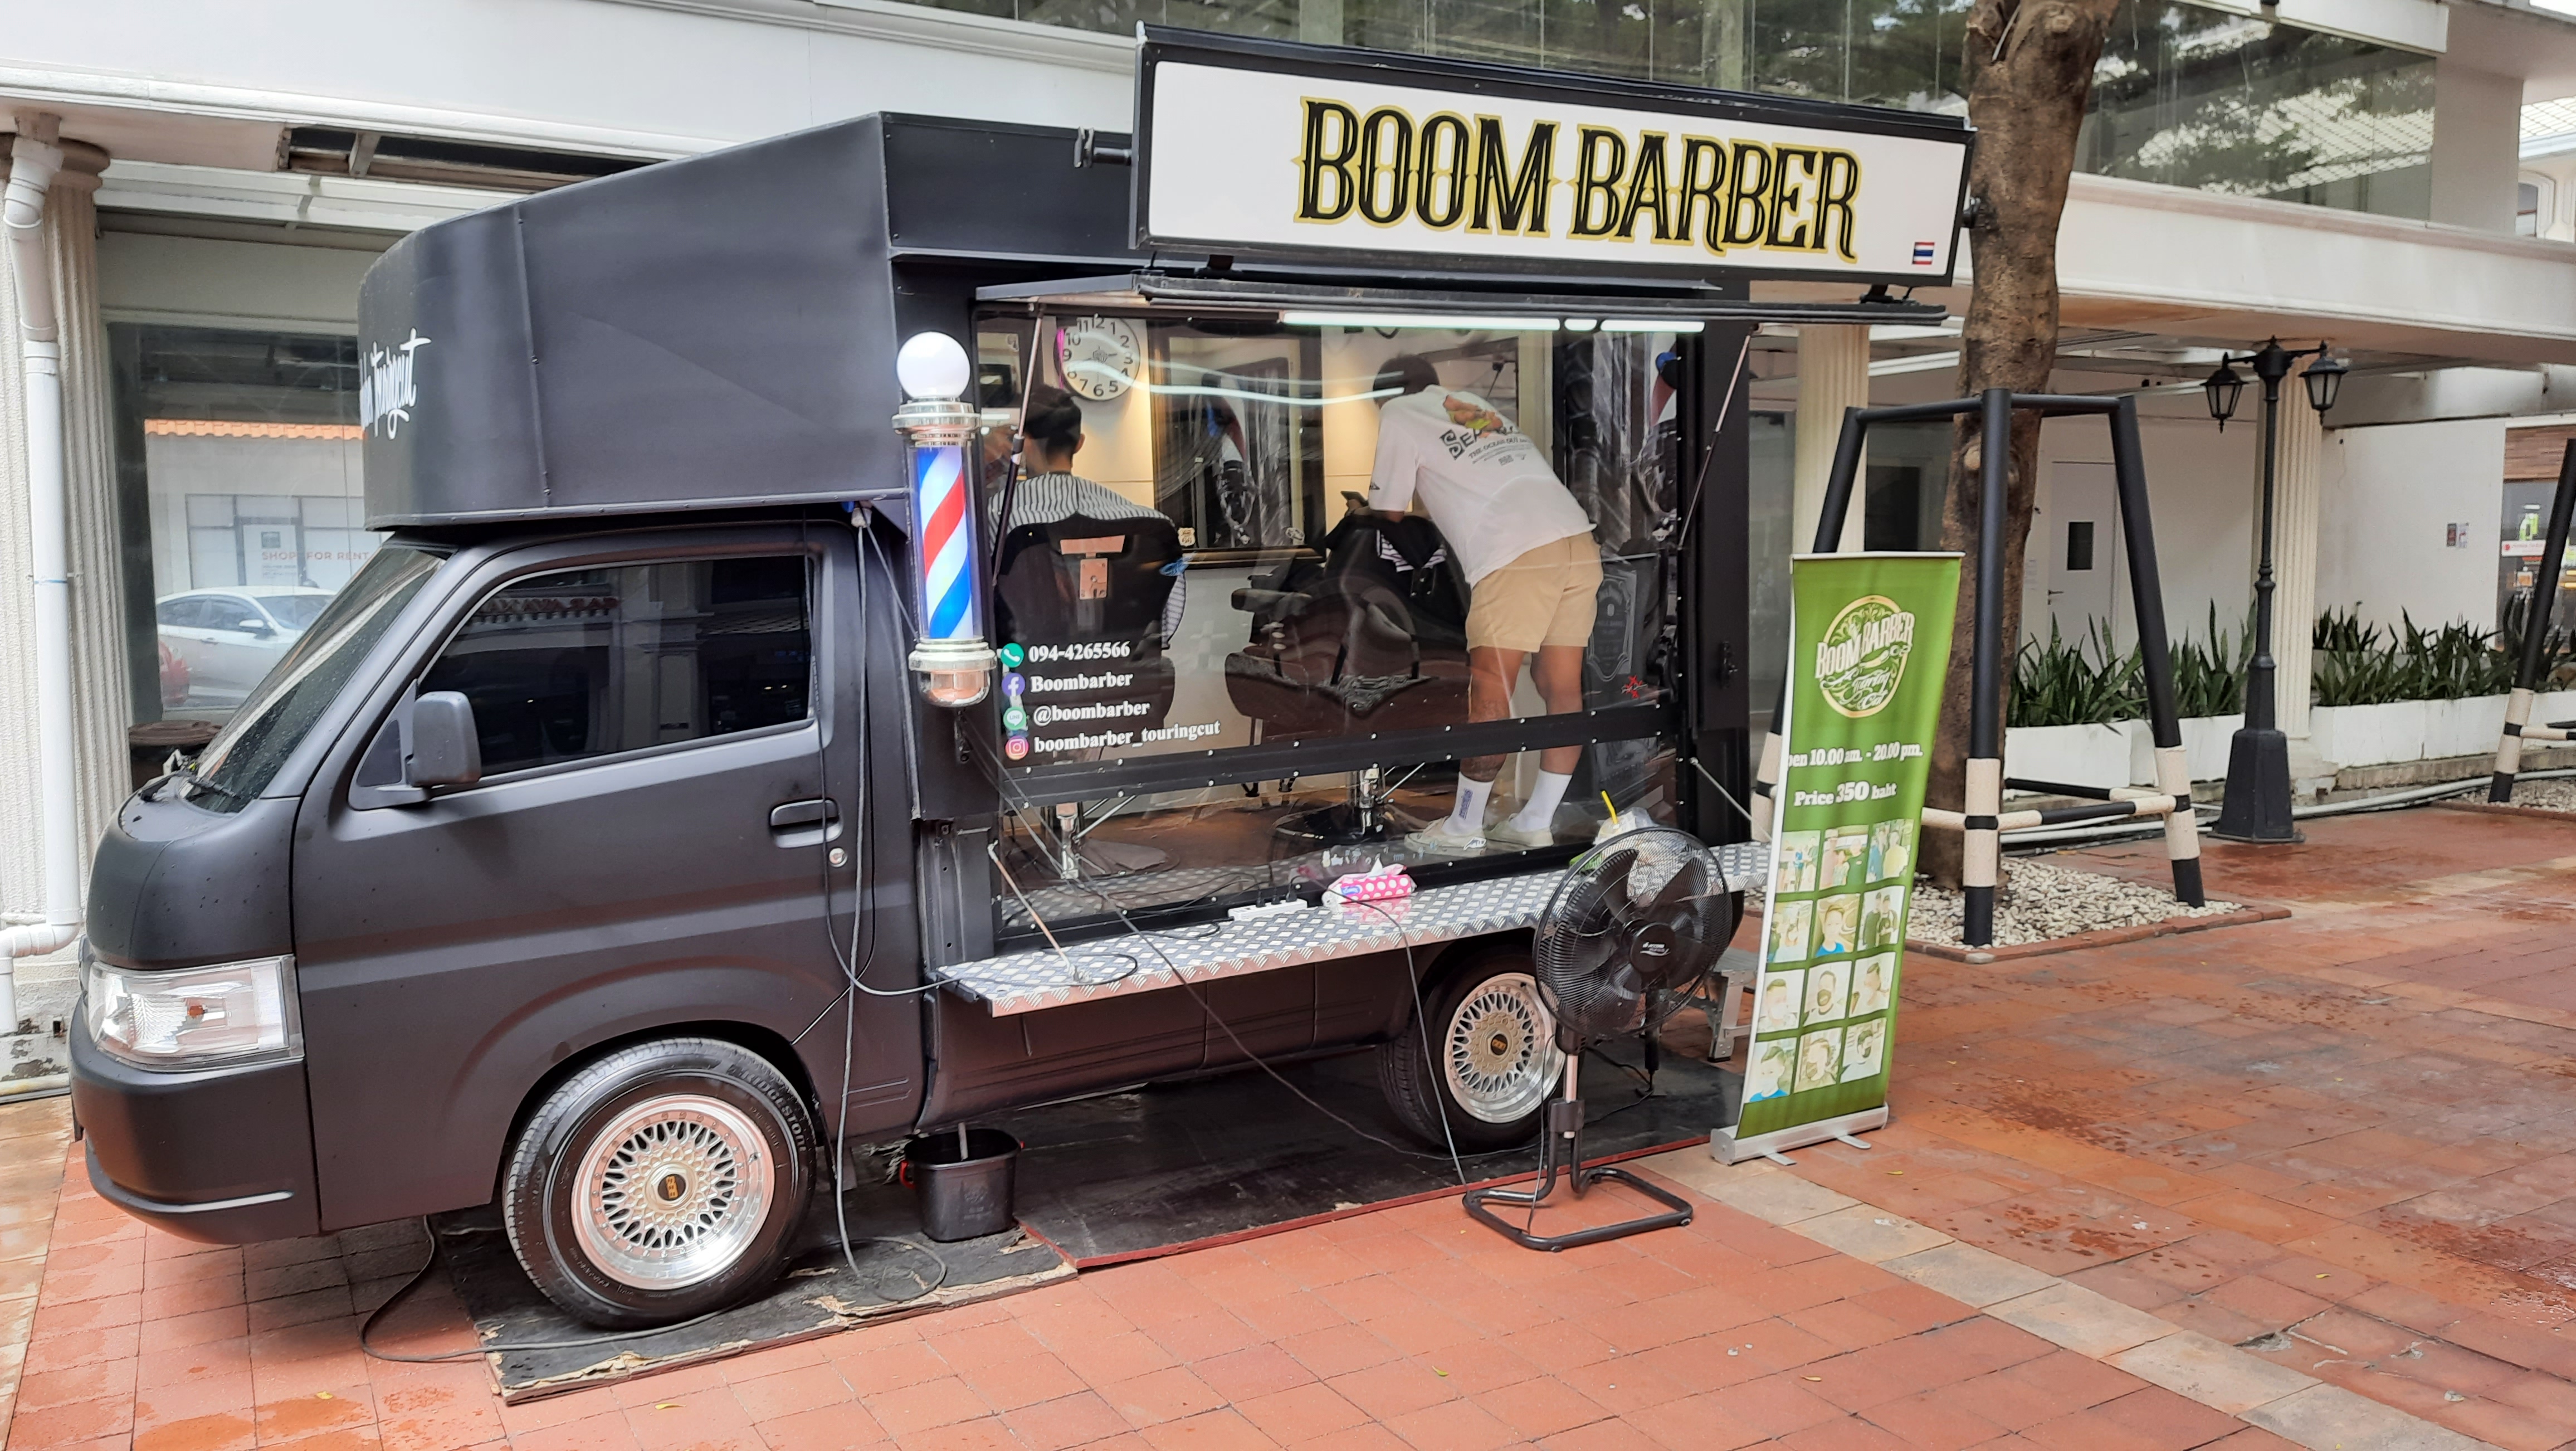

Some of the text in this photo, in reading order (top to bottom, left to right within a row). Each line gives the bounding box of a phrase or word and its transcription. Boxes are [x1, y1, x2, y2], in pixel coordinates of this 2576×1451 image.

[1291, 96, 1861, 264] BOOM BARBER
[1077, 319, 1089, 333] 11
[1092, 317, 1105, 329] 12
[1110, 322, 1116, 335] 1
[1066, 333, 1081, 345] 10
[1120, 335, 1130, 348] 2
[1063, 349, 1072, 361] 9
[1124, 352, 1133, 364] 3
[1080, 378, 1089, 391] 7
[1093, 384, 1104, 397] 6
[1109, 381, 1119, 393] 5
[262, 551, 370, 560] SHOP FOR RENT
[1815, 611, 1915, 679] BOOM BARBER
[1028, 641, 1130, 663] 094-4265566
[1031, 671, 1133, 693] Boombarber
[1034, 700, 1151, 726] @boombarber
[1034, 720, 1221, 753] boombarber_touringcut
[1788, 753, 1808, 768] pen
[1810, 747, 1845, 766] 10.00
[1900, 743, 1923, 762] pm.
[1793, 781, 1897, 807] Price 350 baht
